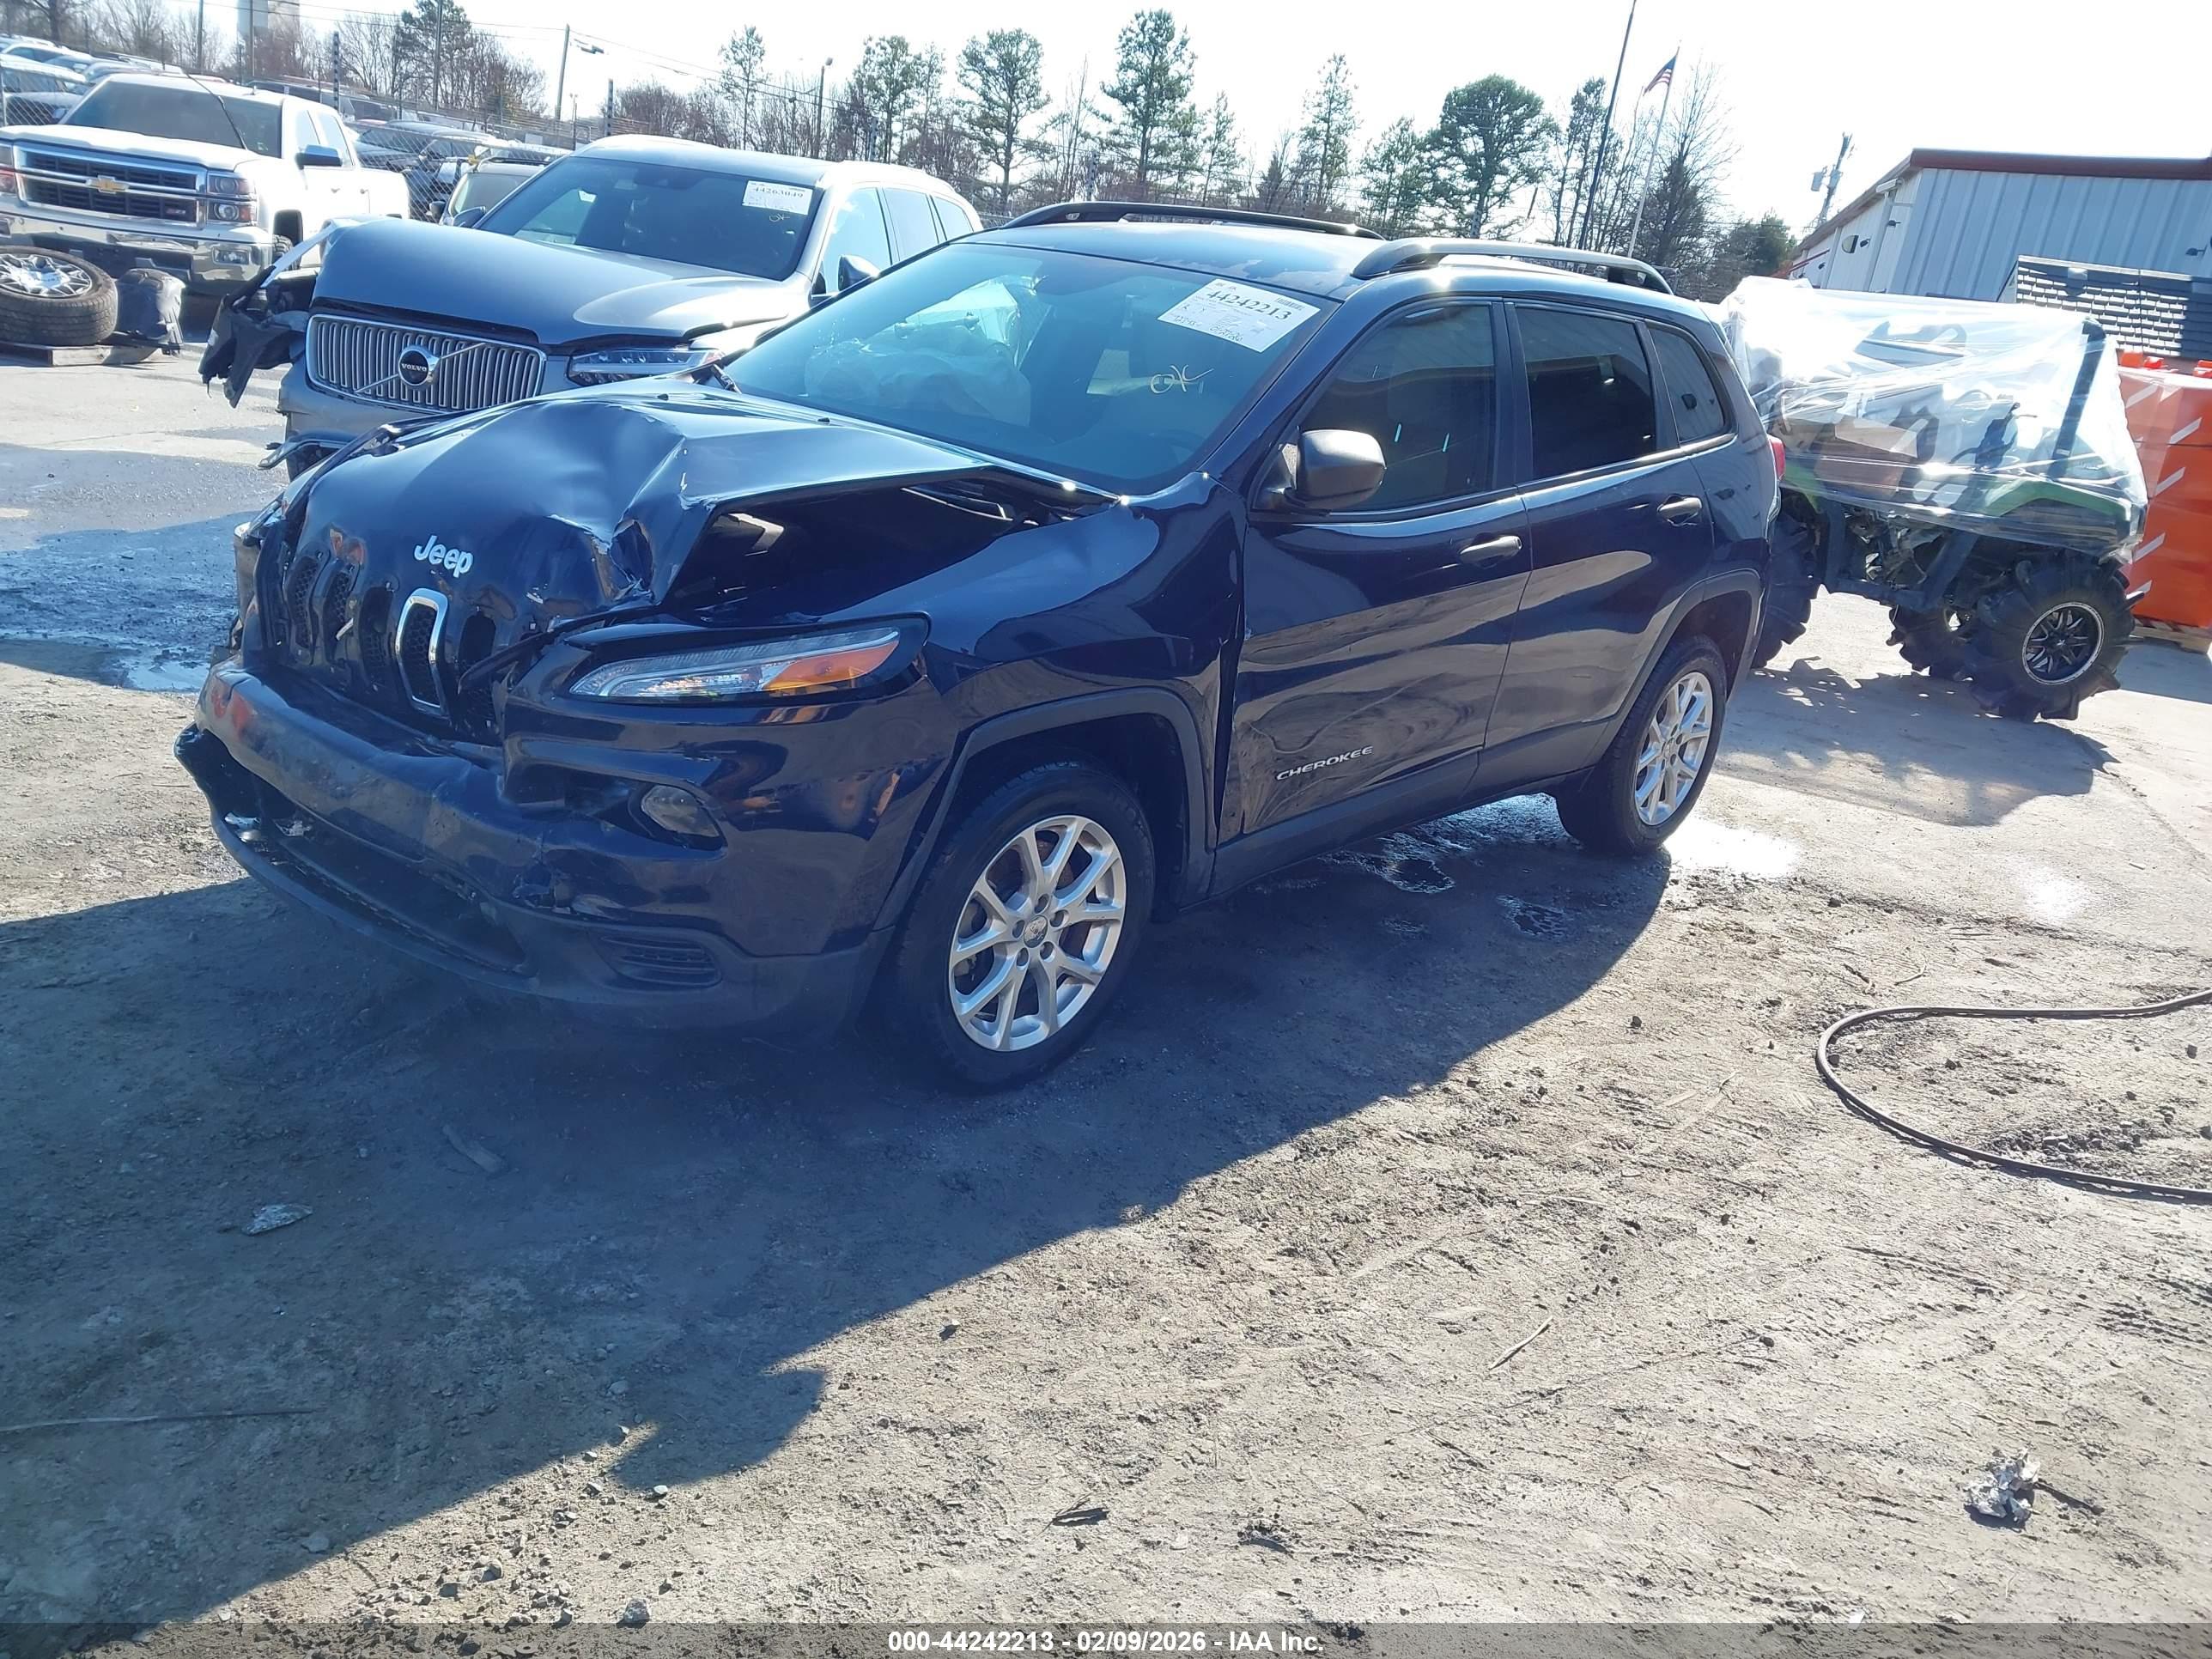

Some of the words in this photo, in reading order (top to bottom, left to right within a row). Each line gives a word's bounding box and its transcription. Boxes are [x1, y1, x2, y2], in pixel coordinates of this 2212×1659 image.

[1206, 290, 1292, 320] 44242213
[401, 363, 428, 372] VOLVO
[1150, 364, 1215, 394] OK
[414, 534, 474, 579] Jeep
[1276, 745, 1374, 781] CHEROKEE
